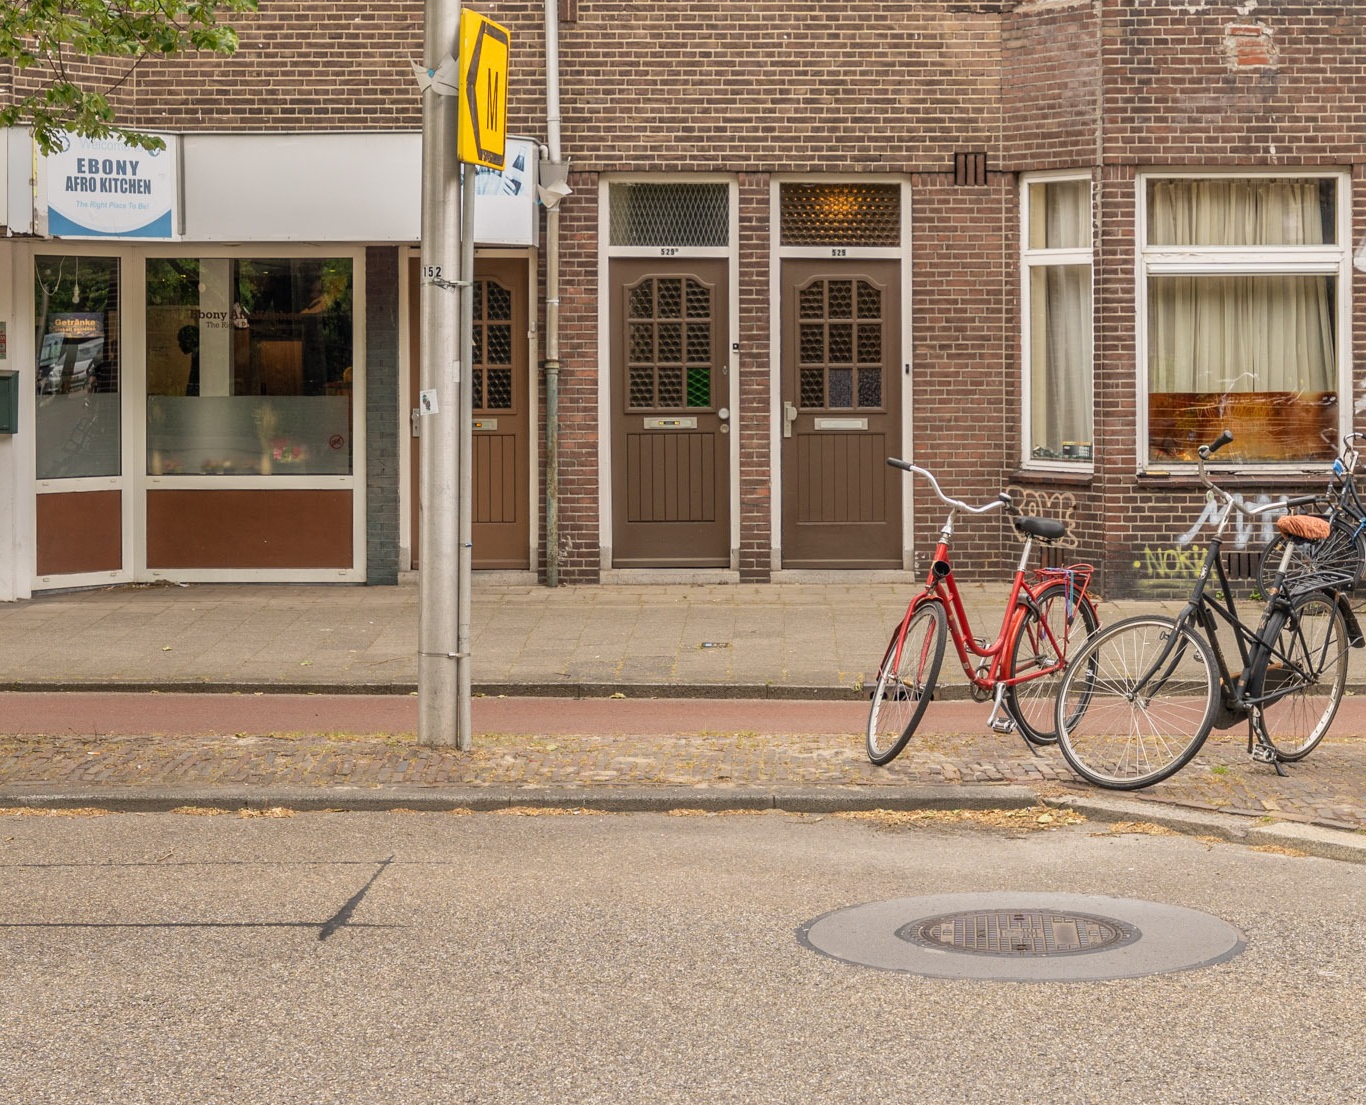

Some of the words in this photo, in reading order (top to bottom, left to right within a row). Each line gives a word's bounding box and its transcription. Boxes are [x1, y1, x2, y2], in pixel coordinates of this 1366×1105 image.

[487, 67, 499, 133] M
[76, 157, 140, 176] EBONY
[65, 175, 97, 193] AFRO
[99, 177, 152, 195] KITCHEN
[76, 200, 89, 208] The
[831, 249, 847, 257] 529
[423, 266, 442, 278] 152
